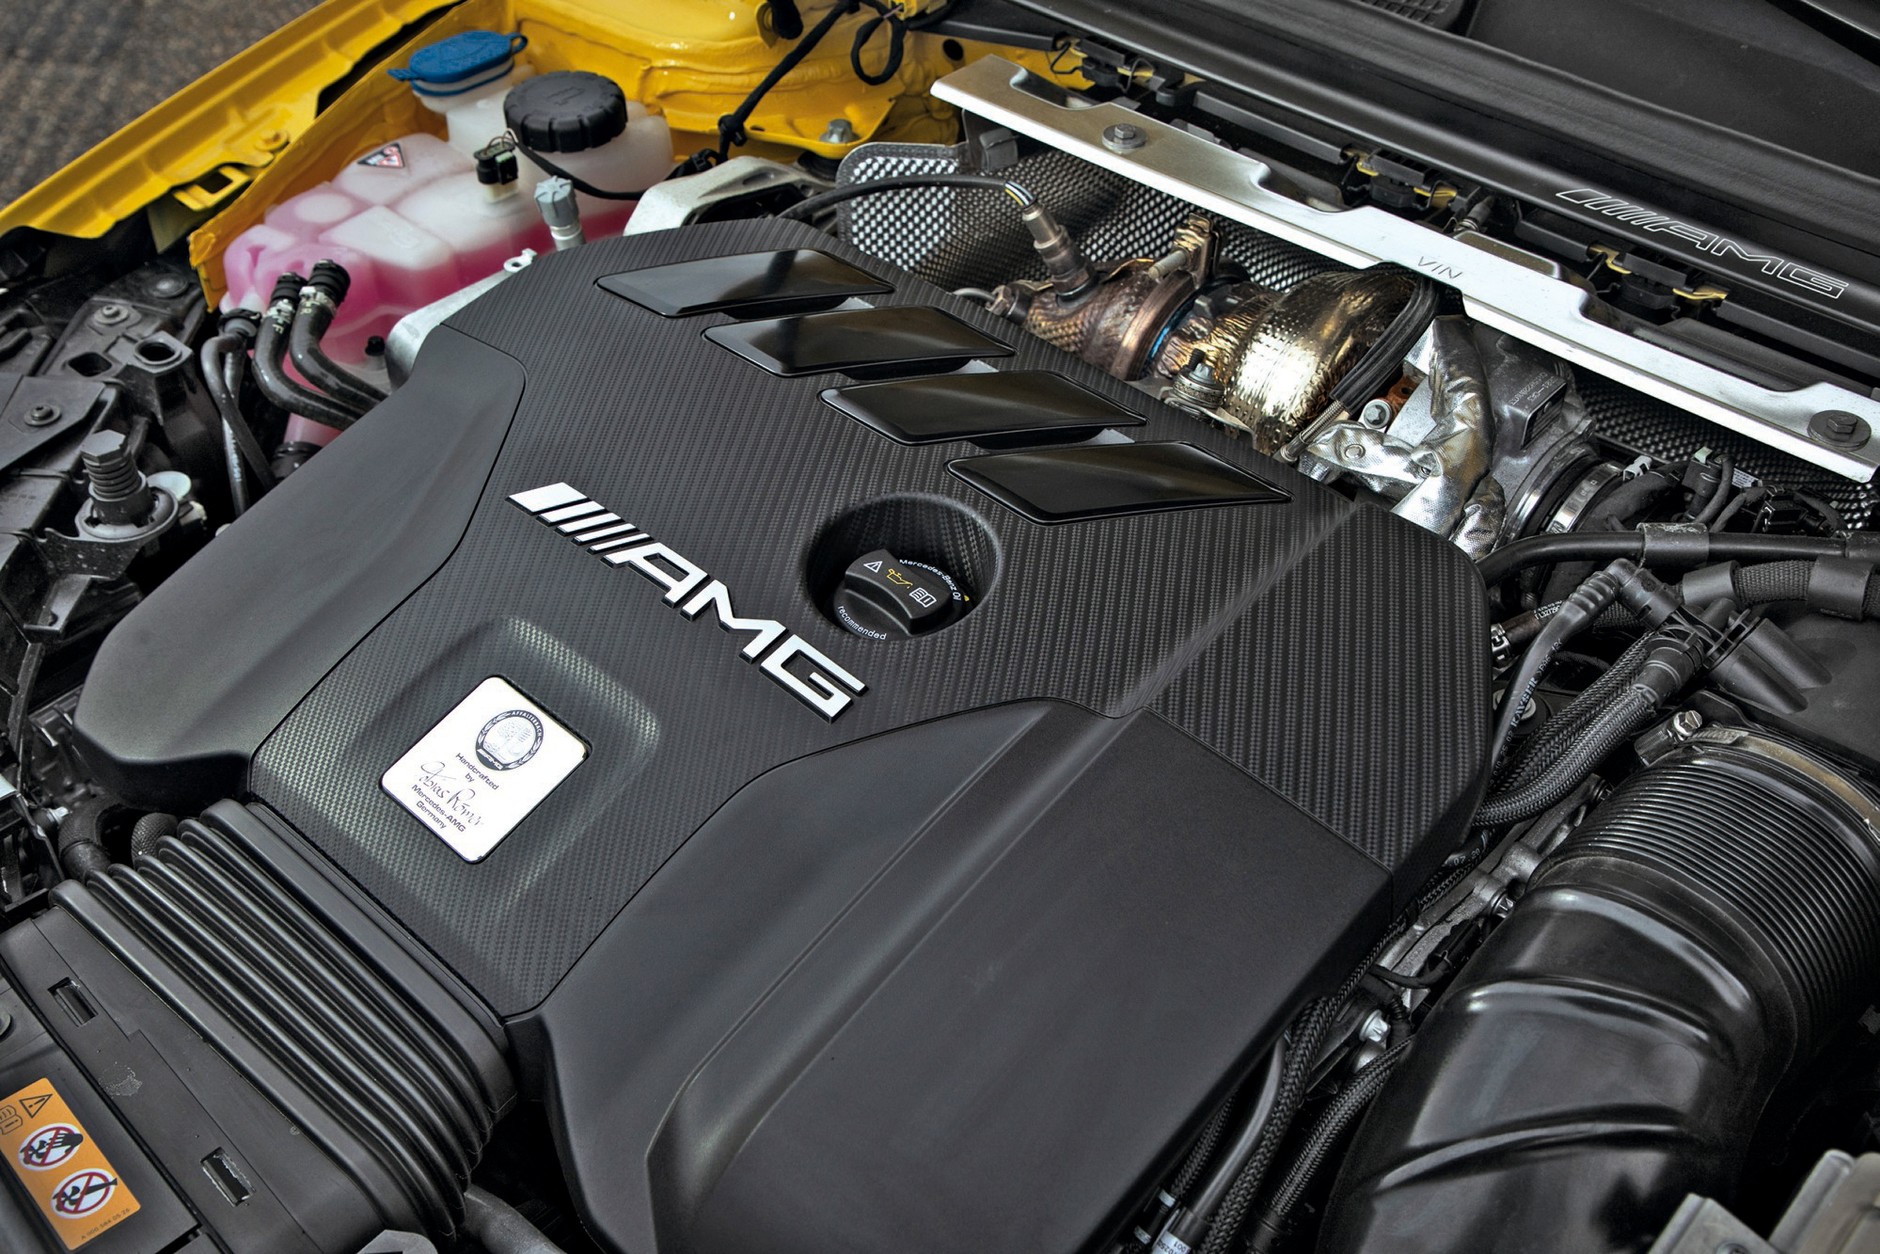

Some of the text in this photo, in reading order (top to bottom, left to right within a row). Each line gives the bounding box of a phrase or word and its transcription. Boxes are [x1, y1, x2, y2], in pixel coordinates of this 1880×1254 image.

[1417, 255, 1463, 279] VIN
[1643, 220, 1849, 299] AMG
[899, 559, 958, 591] Mercedes-Benz
[600, 541, 869, 724] AMG
[837, 605, 888, 640] recommended
[455, 752, 499, 790] Handcrafted
[465, 773, 475, 783] by
[411, 784, 466, 832] Mercedes-AMG
[416, 801, 446, 829] Germany
